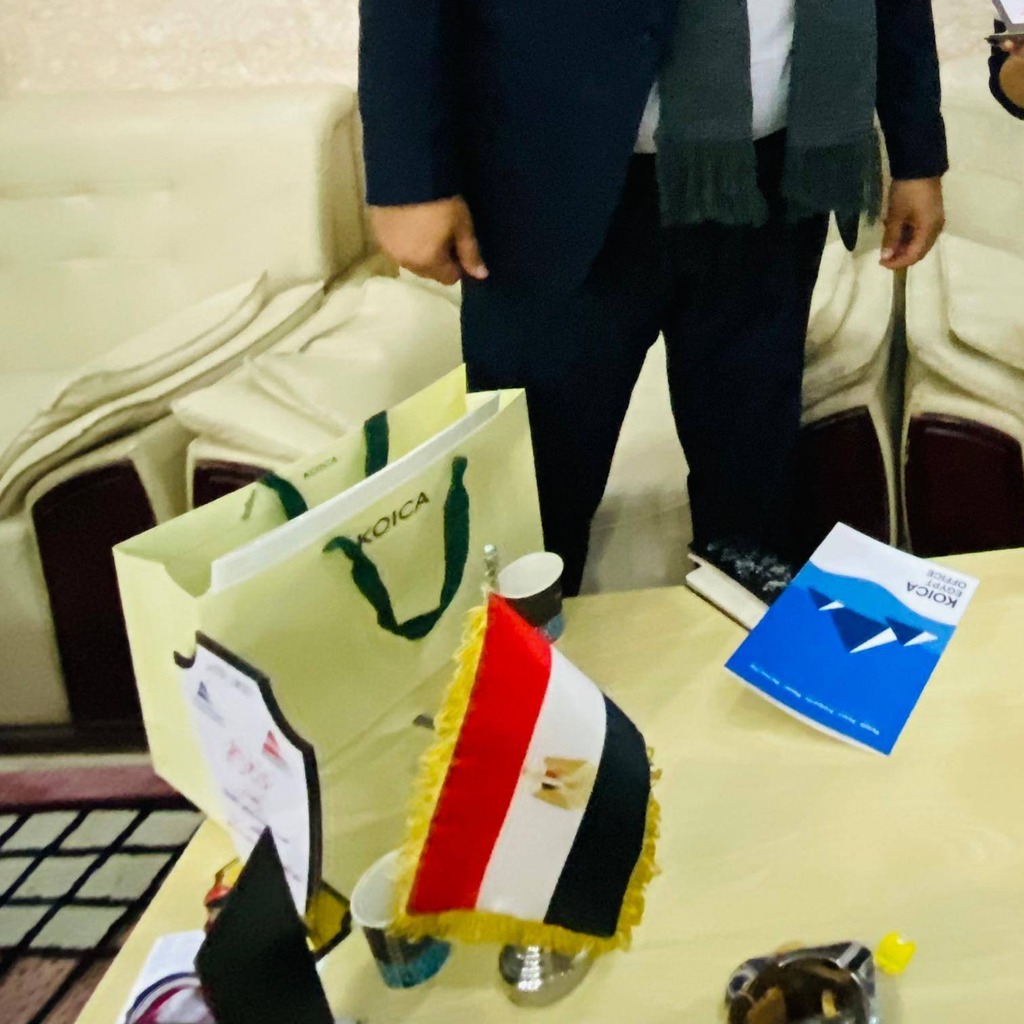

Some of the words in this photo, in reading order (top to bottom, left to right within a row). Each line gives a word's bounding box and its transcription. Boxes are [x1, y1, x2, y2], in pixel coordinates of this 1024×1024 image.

[358, 492, 429, 545] KOICA
[927, 570, 967, 589] OFFICE
[927, 579, 962, 597] EGYPT
[907, 582, 957, 608] KOICA
